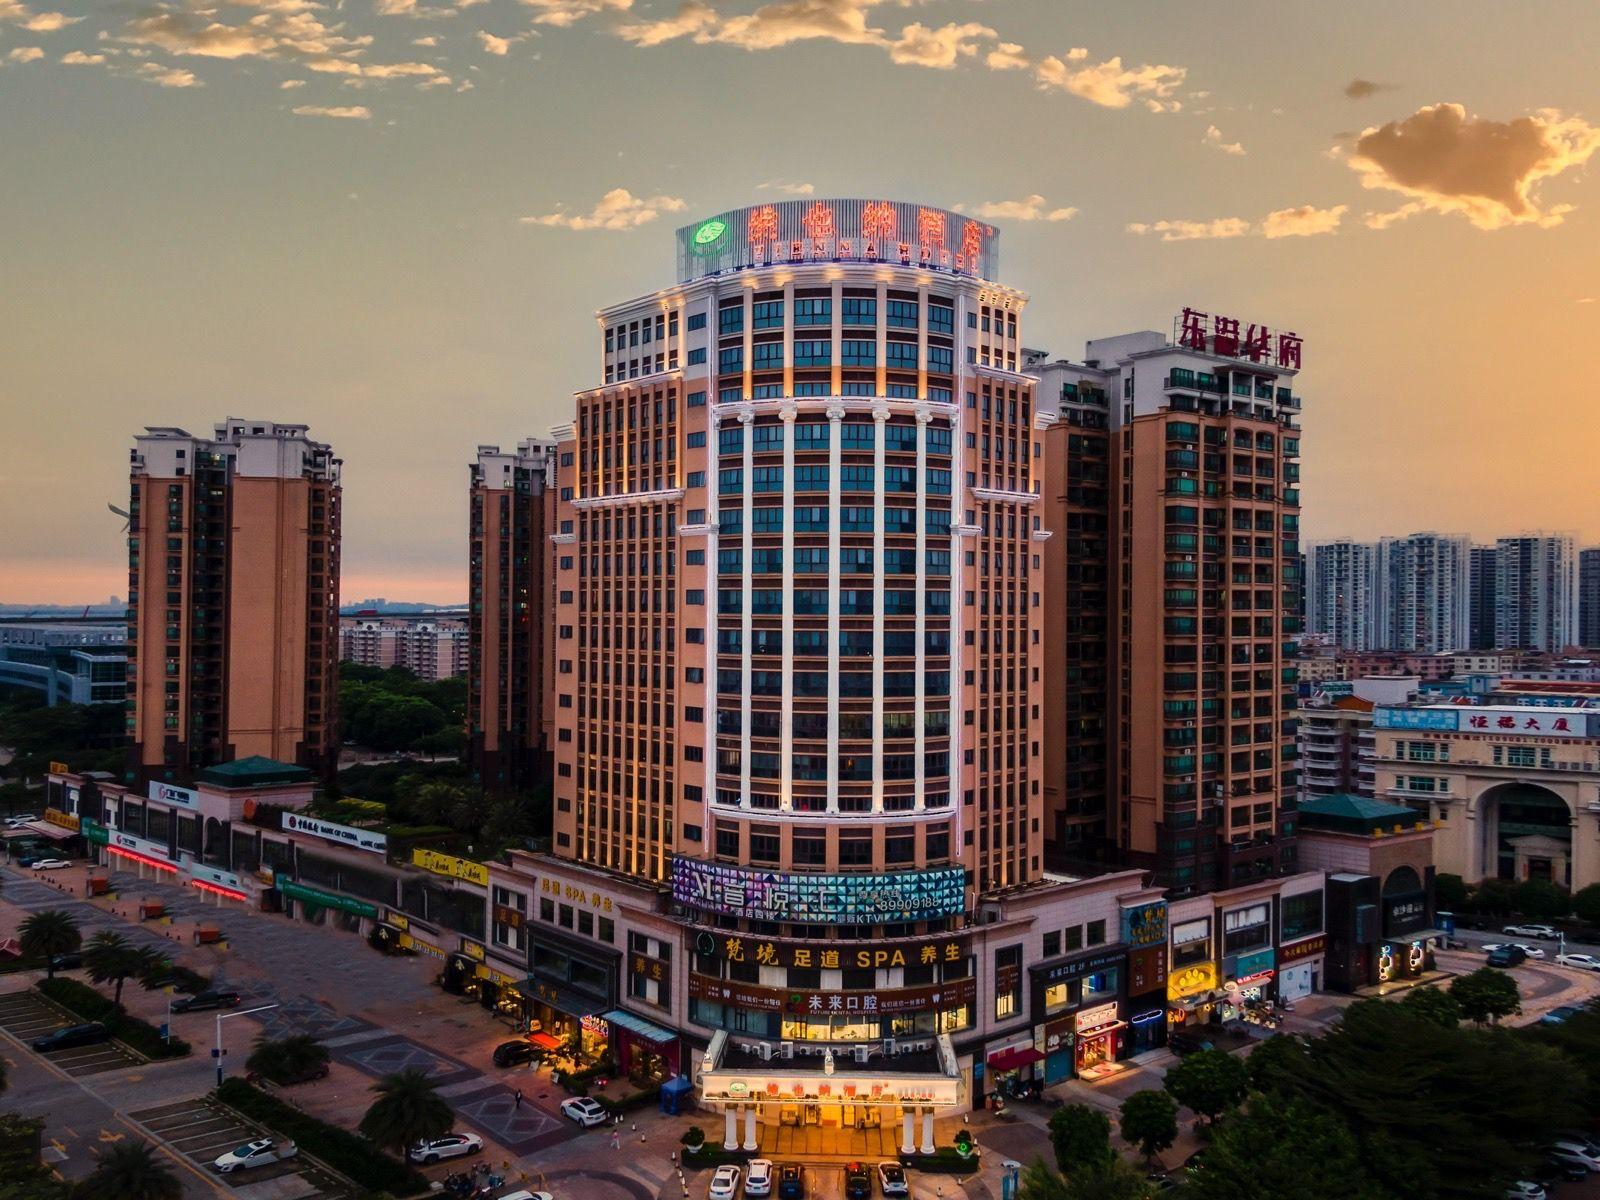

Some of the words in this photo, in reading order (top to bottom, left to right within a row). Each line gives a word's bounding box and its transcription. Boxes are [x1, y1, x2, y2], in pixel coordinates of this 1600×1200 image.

[880, 896, 940, 911] 89909188
[857, 949, 906, 968] SPA
[920, 943, 960, 964] 养生
[808, 994, 878, 1010] 未来口腔
